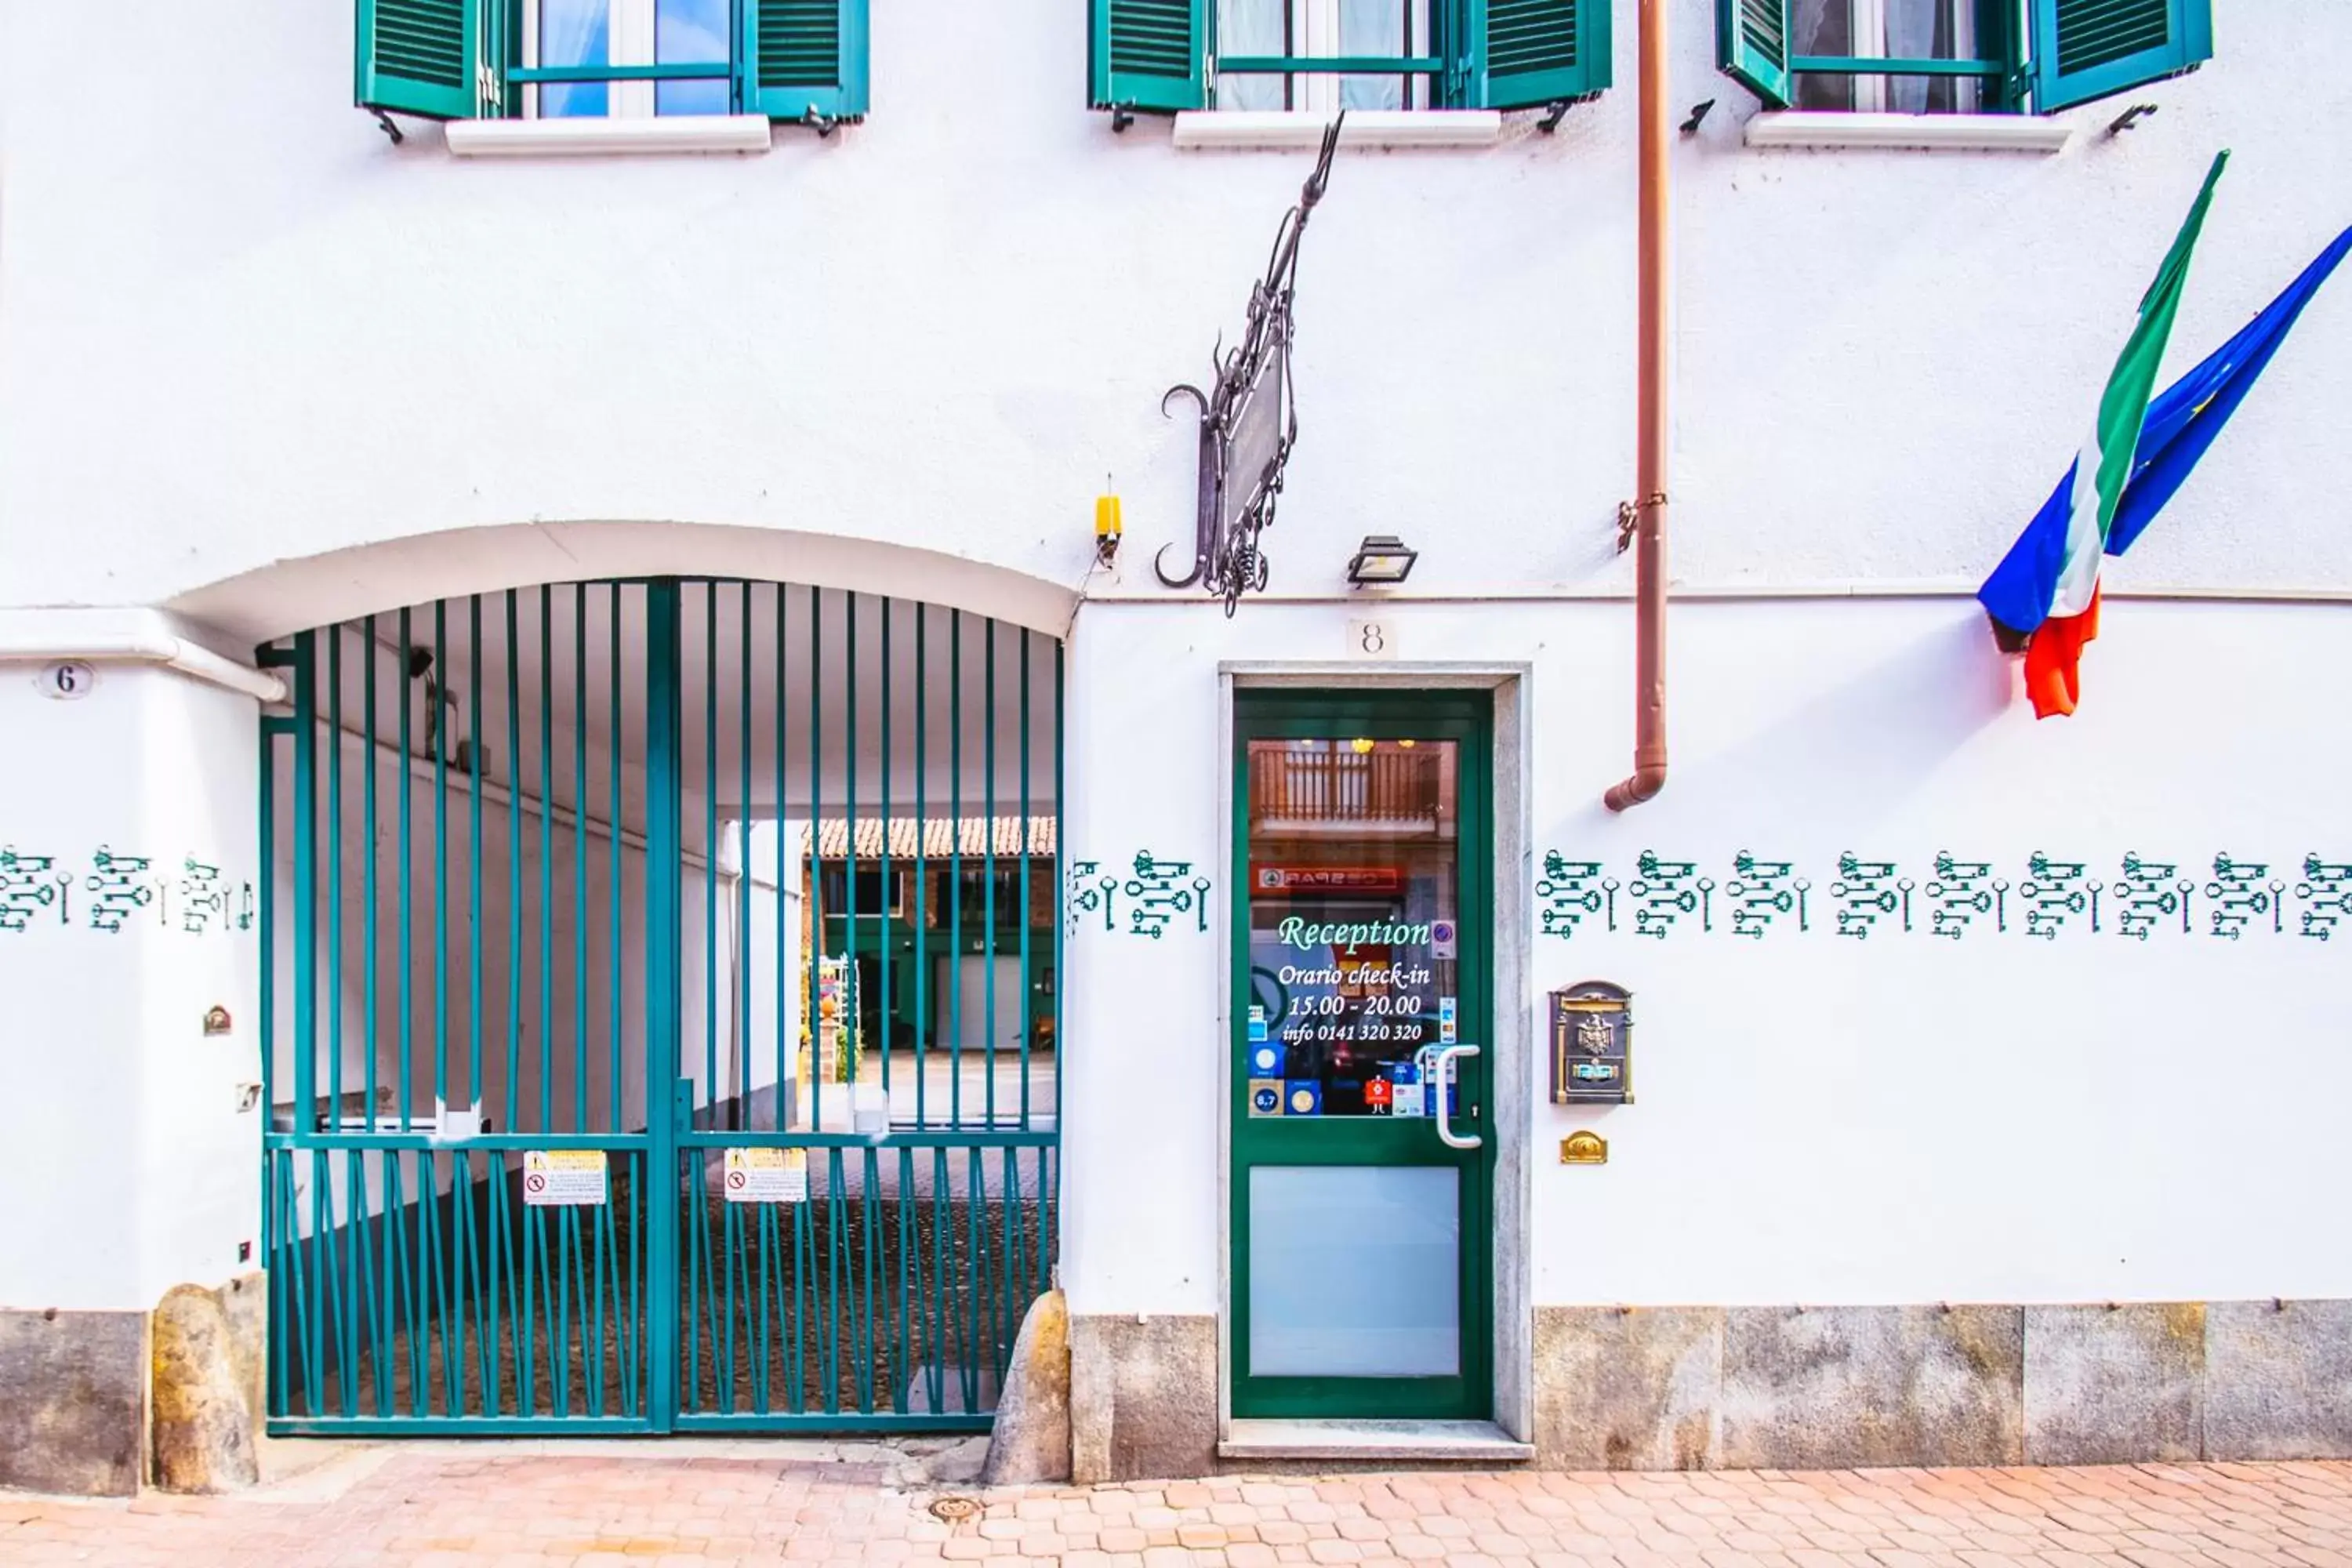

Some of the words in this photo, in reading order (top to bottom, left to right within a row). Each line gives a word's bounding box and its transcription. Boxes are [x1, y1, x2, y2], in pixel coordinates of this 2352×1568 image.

[1362, 623, 1384, 654] 8
[56, 665, 75, 692] 6
[1279, 915, 1430, 955] Reception
[1279, 964, 1343, 984] Orario
[1348, 961, 1430, 988] check-in
[1289, 995, 1345, 1015] 15.00
[1363, 995, 1421, 1015] 20.00
[1283, 1023, 1314, 1045] info
[1318, 1025, 1355, 1040] 0141
[1358, 1025, 1390, 1040] 320
[1392, 1025, 1422, 1040] 320
